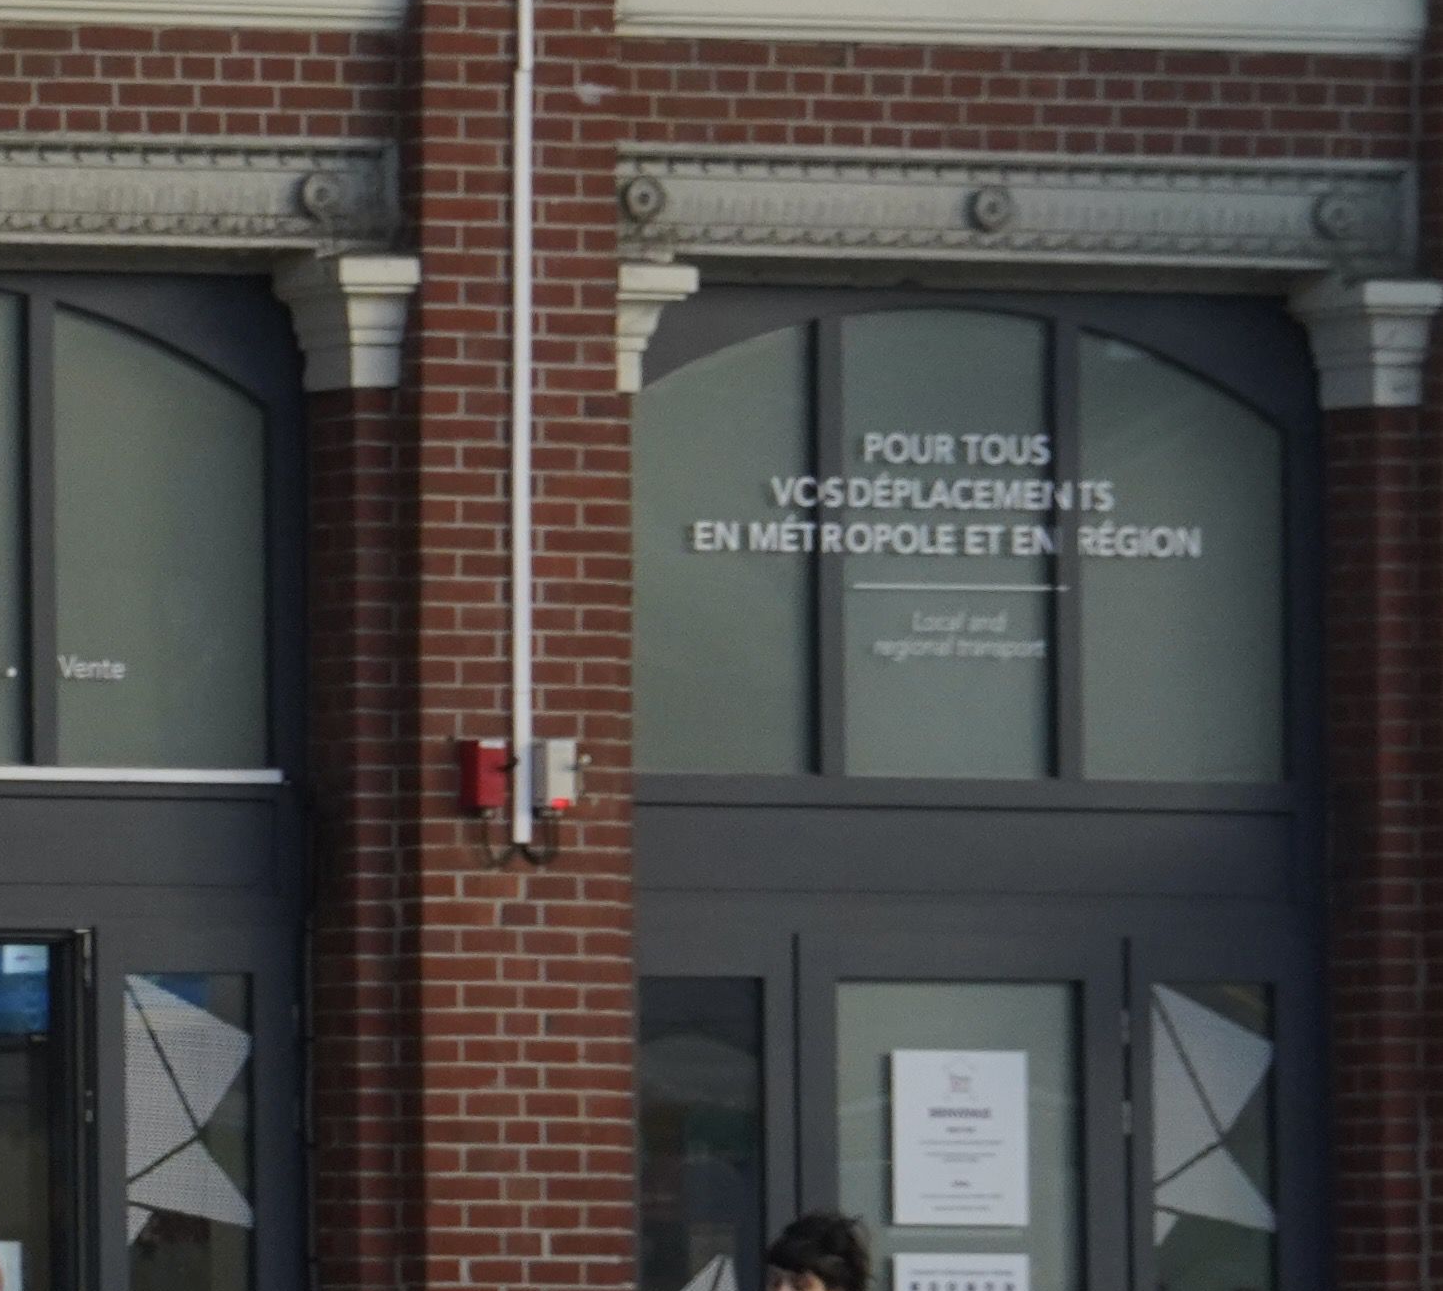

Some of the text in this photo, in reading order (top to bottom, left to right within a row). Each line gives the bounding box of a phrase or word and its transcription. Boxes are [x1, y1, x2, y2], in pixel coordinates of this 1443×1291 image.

[864, 432, 1051, 466] POUR TOUS
[771, 472, 1115, 513] VOS DÉPLACEMENTS
[693, 513, 1203, 559] EN MÉTROPOLE ET EN RÉGION
[57, 653, 126, 680] Vente
